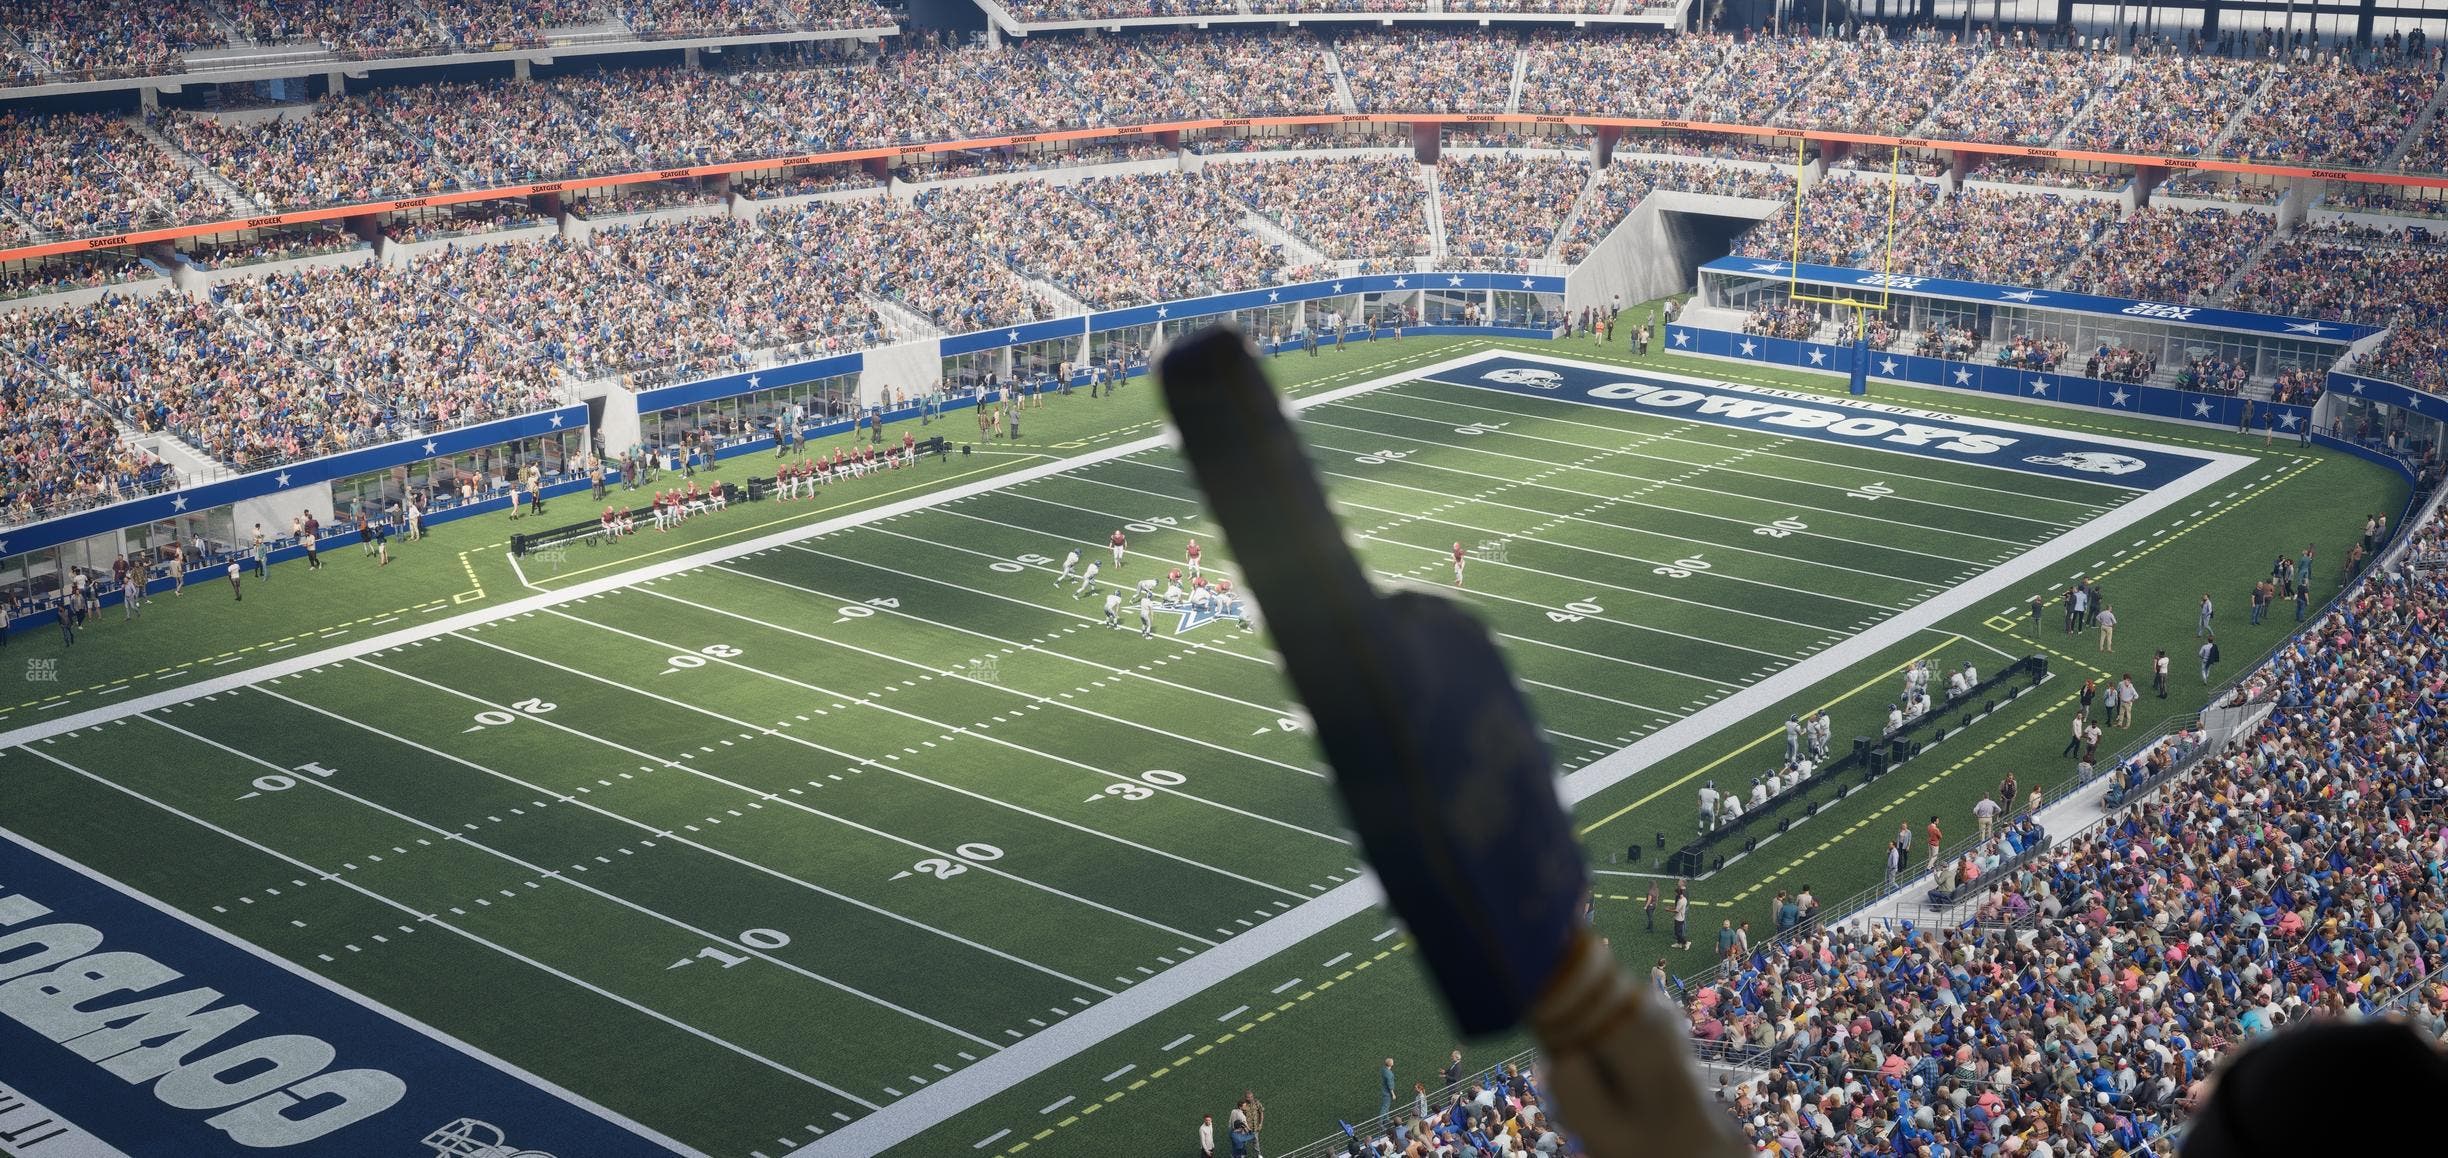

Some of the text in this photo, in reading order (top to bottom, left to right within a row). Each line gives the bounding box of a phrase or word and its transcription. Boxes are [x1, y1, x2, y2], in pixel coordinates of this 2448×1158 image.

[1011, 136, 1036, 144] SEATGEEK
[1777, 129, 1805, 137] SEATGEEK
[900, 146, 926, 154] SEATGEEK
[1899, 139, 1929, 147] SEATGEEK
[2028, 149, 2058, 157] SEATGEEK
[783, 157, 810, 166] SEATGEEK
[2165, 159, 2199, 168] SEATGEEK
[661, 169, 689, 178] SEATGEEK
[2311, 171, 2347, 180] SEATGEEK
[532, 183, 562, 193] SEATGEEK
[395, 199, 427, 209] SEATGEEK
[248, 216, 282, 227] SEATGEEK
[89, 236, 127, 248] SEATGEEK
[2122, 308, 2194, 320] GEEK
[2133, 302, 2200, 314] SEAT
[1716, 382, 1738, 390] IT
[1751, 387, 1825, 401] TAKES
[1828, 399, 1871, 409] ALL
[1925, 413, 1959, 421] US
[1587, 382, 2021, 454] COWBOYS
[1454, 422, 1491, 436] 10
[1355, 450, 1407, 466] 20
[1846, 485, 1895, 501] 10
[1124, 515, 1178, 533] 40
[1752, 520, 1809, 538] 20
[989, 553, 1055, 572] 50
[1652, 559, 1712, 579] 30
[838, 597, 902, 618] 40
[1545, 602, 1605, 623] 40
[668, 644, 743, 669] 30
[474, 698, 558, 725] 20
[252, 761, 339, 792] 10
[1104, 769, 1187, 802] 30
[914, 842, 1005, 881] 20
[695, 928, 792, 969] 10
